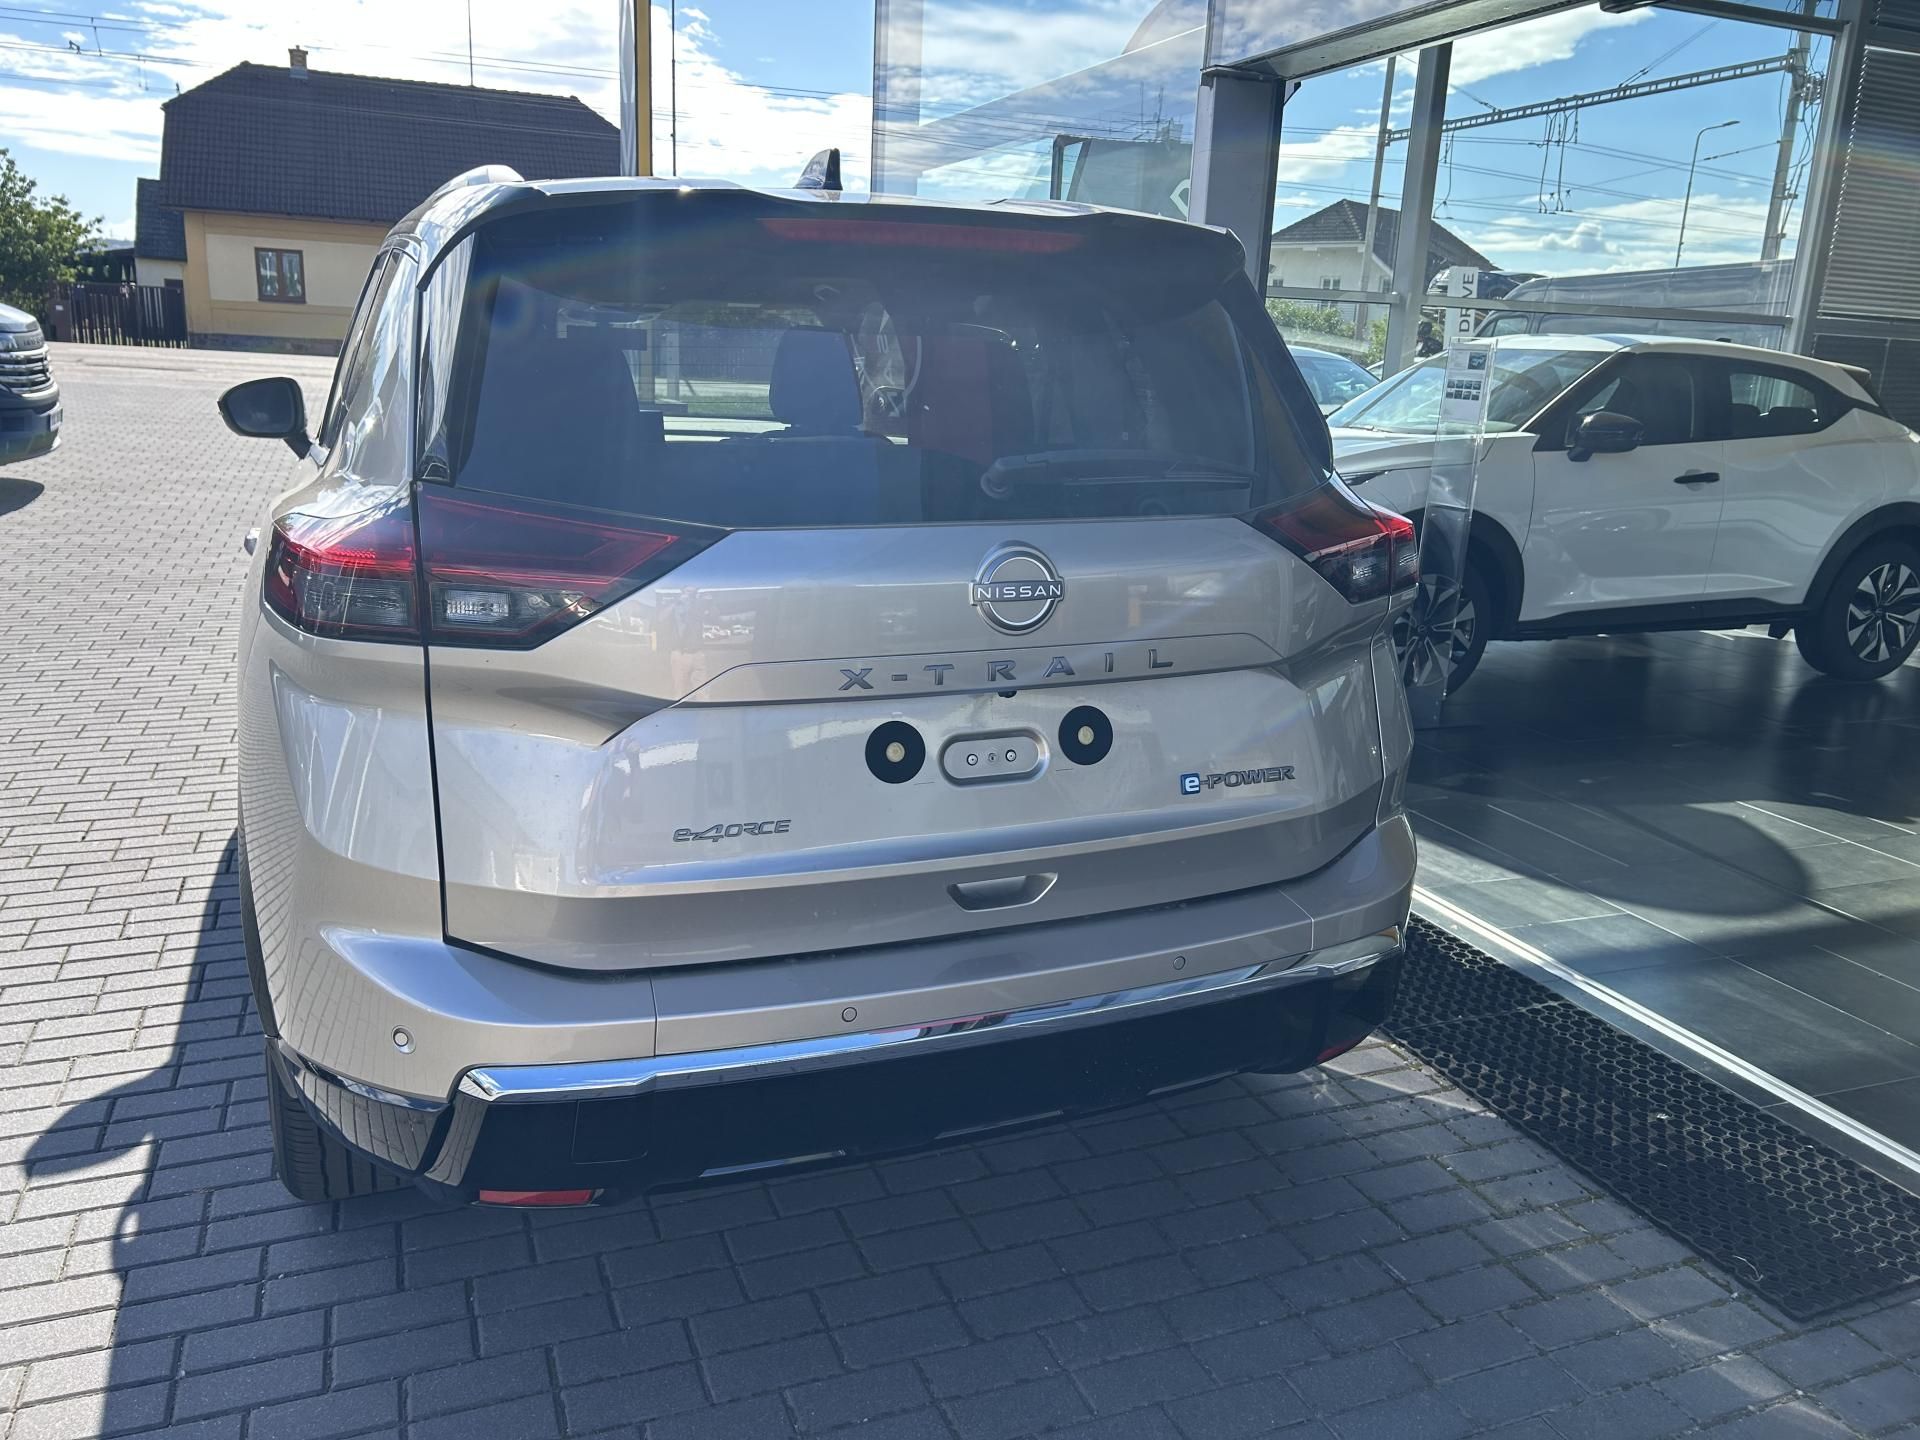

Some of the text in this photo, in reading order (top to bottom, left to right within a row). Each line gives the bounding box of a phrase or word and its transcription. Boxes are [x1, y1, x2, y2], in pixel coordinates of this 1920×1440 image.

[1458, 272, 1475, 333] DRVE
[977, 584, 1061, 598] NISSAN
[838, 648, 1174, 691] X-TRAIL
[1181, 765, 1296, 795] e-POWER
